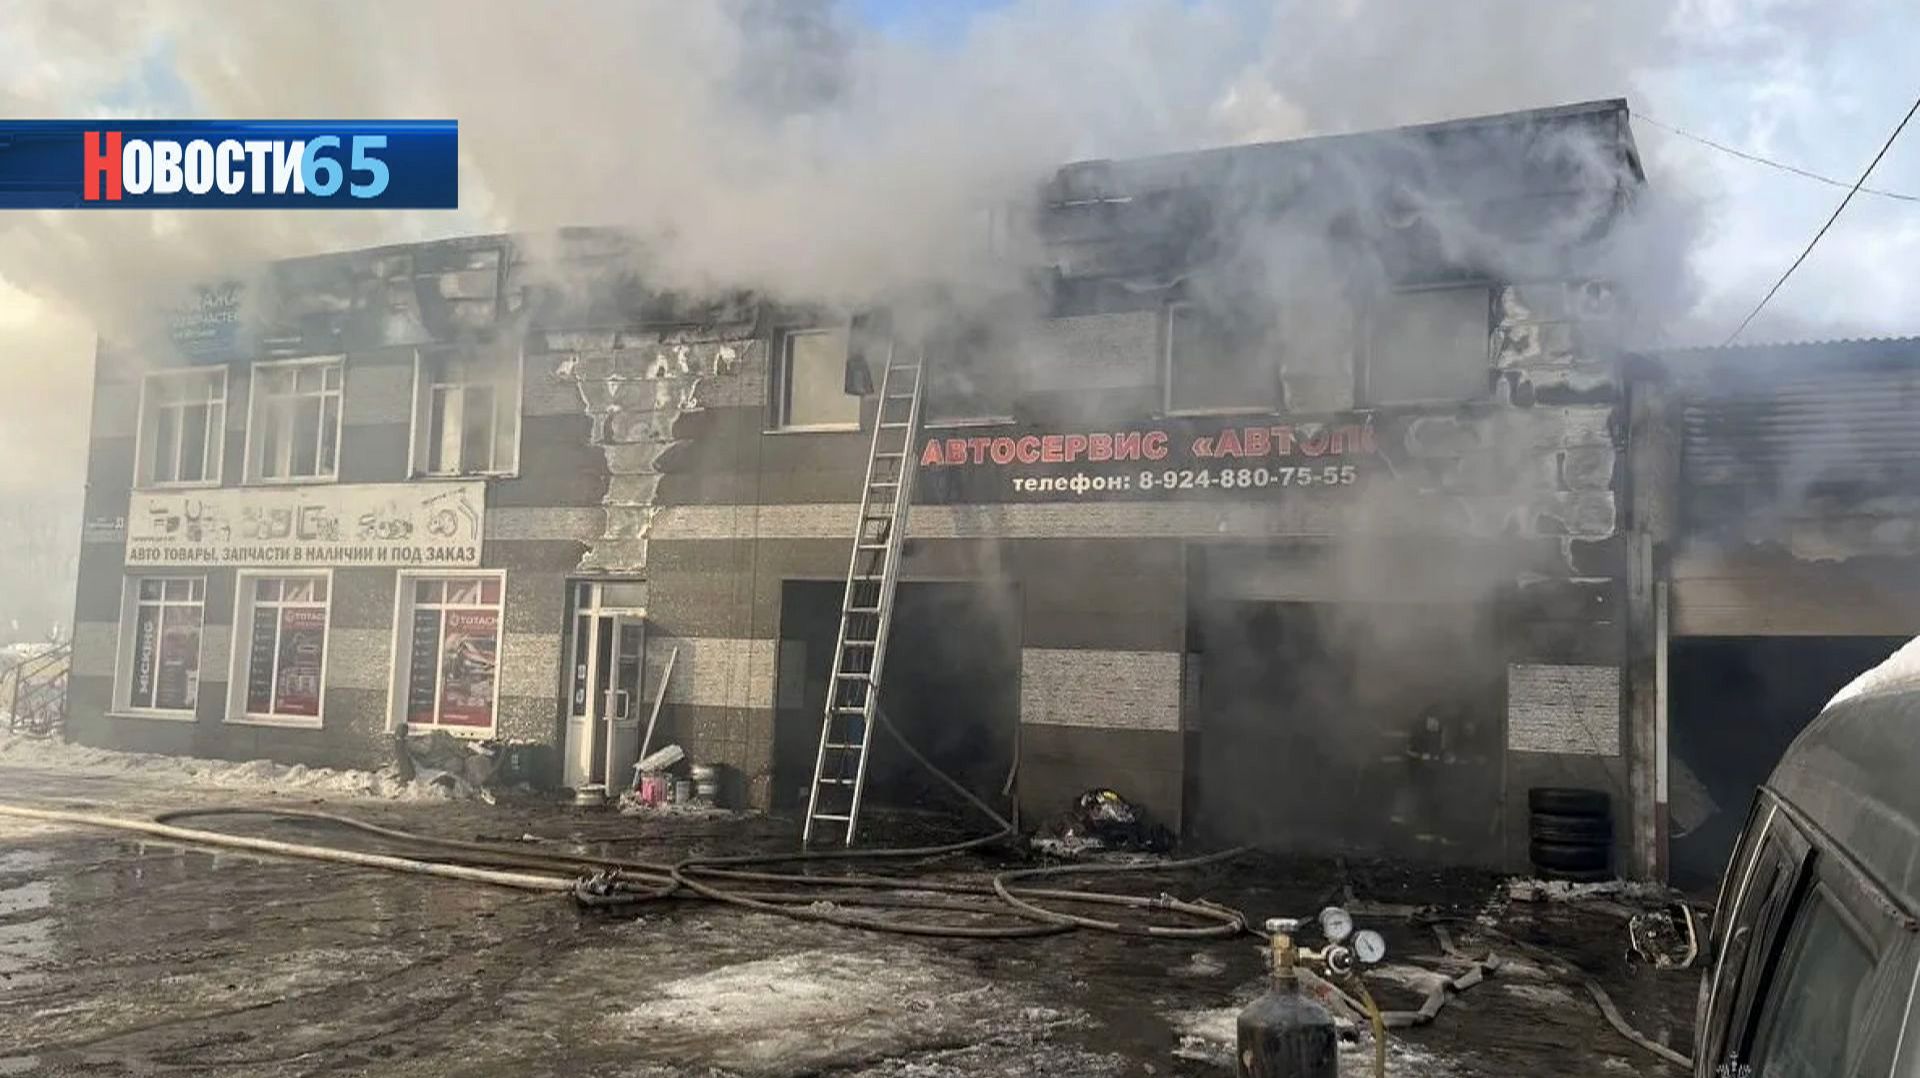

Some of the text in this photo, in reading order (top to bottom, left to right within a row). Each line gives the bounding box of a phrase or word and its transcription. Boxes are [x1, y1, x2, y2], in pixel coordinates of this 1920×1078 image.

[920, 431, 1168, 466] АВТОСЕРВИС
[1012, 465, 1357, 494] телефон: 8-924-880-75-55
[130, 548, 160, 561] АВТО
[223, 547, 289, 561] ЗАПЧАСТИ
[294, 547, 302, 560] В
[305, 547, 373, 561] НАЛИЧИИ
[377, 547, 387, 561] И
[391, 547, 422, 563] ПОД
[425, 547, 475, 561] ЗАКАЗ
